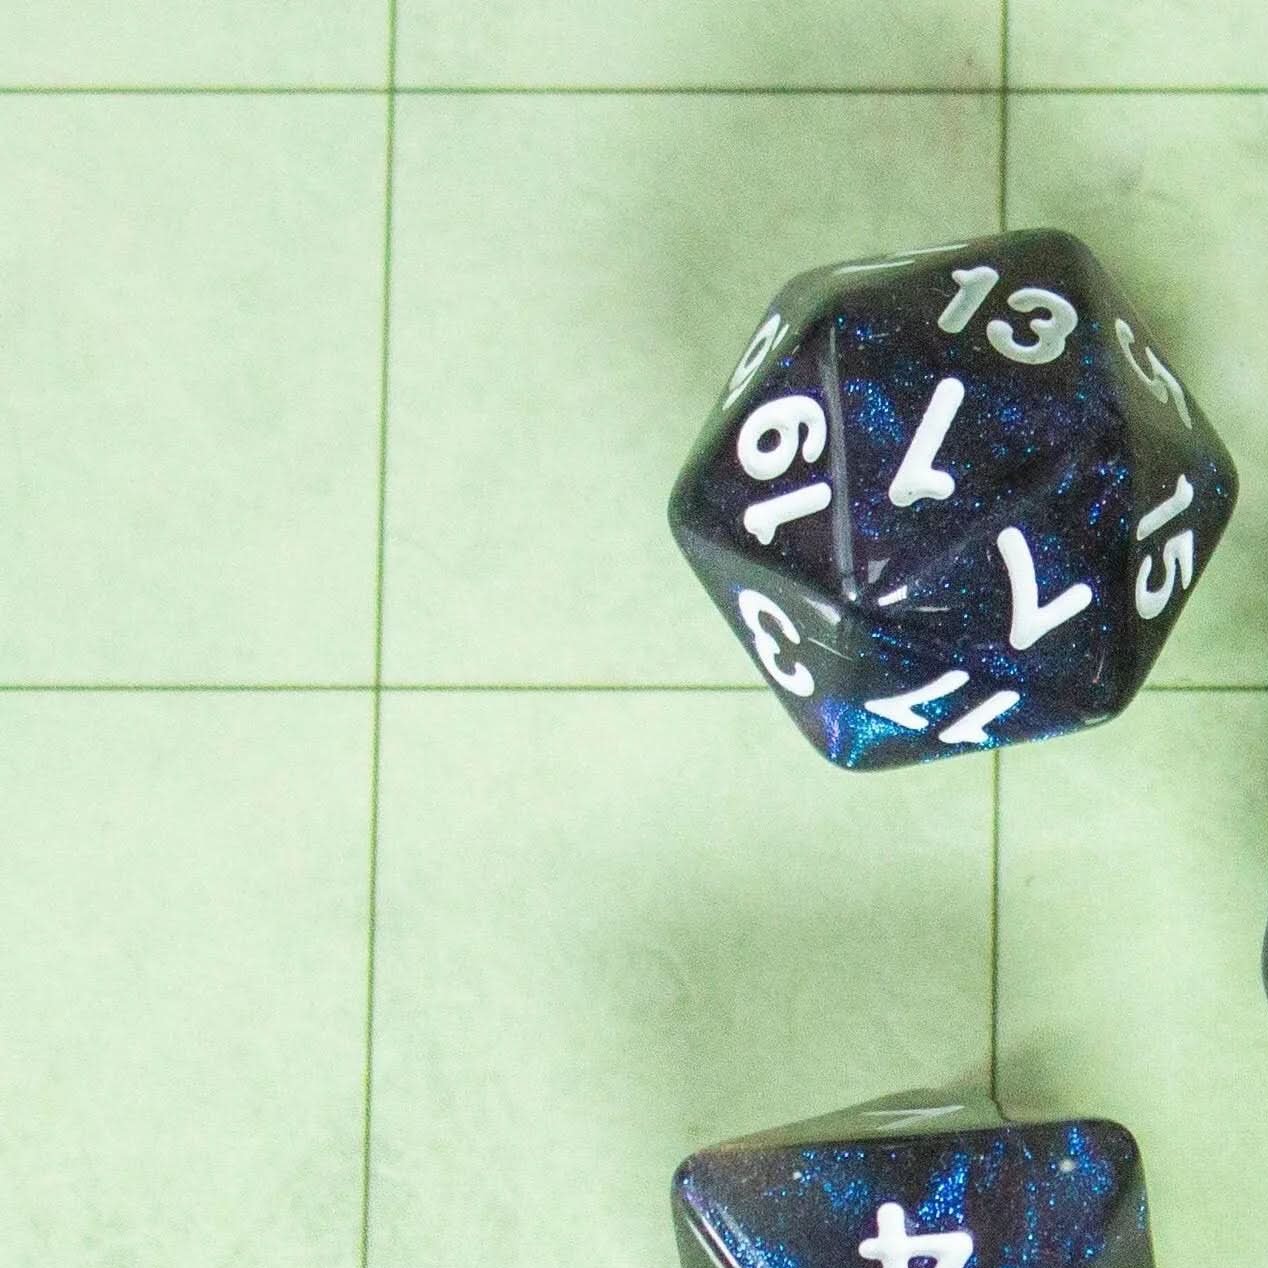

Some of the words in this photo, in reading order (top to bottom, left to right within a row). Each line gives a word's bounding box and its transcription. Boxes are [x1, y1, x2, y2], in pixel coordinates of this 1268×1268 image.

[936, 264, 1079, 366] 13
[736, 394, 833, 546] 19
[887, 376, 966, 508] 1
[995, 526, 1094, 652] 7
[1133, 470, 1196, 623] 15
[733, 587, 816, 702] 3
[862, 665, 1025, 748] 17
